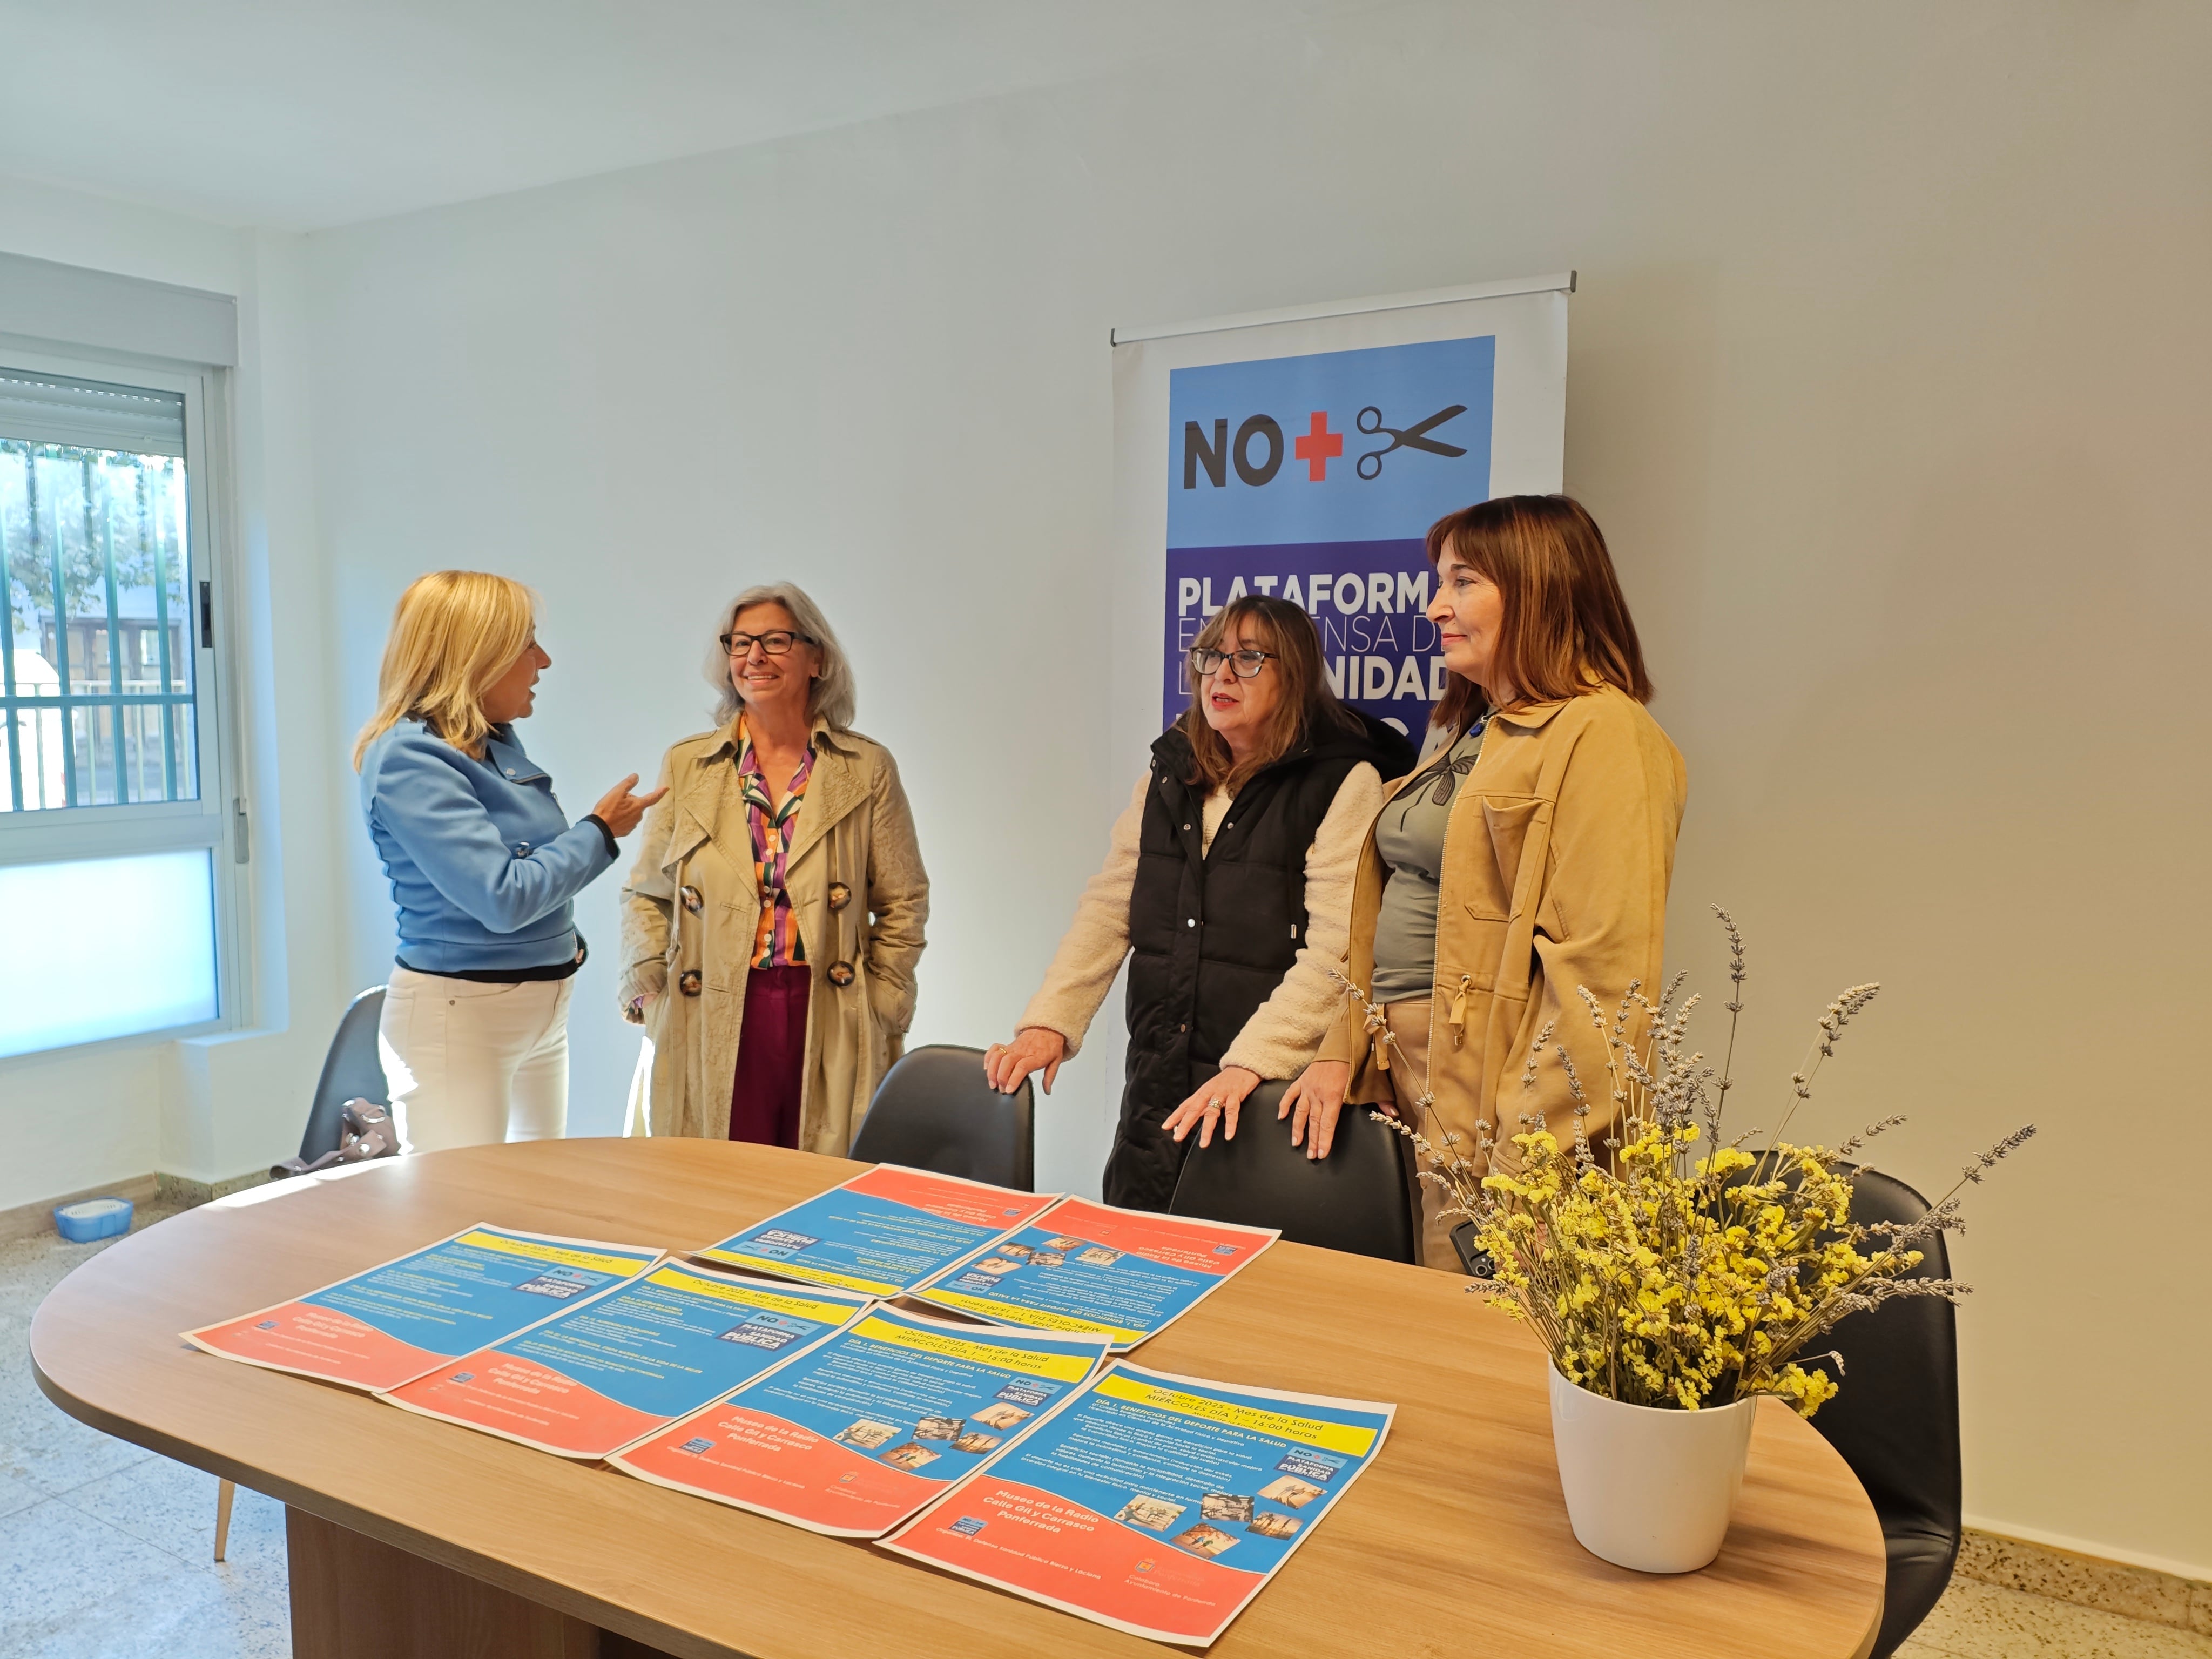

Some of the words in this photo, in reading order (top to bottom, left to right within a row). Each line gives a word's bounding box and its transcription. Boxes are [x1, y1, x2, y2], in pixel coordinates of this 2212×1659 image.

[1184, 414, 1284, 490] NO
[1179, 571, 1429, 616] PLATAFORM
[960, 1299, 986, 1307] horas
[1047, 1318, 1102, 1332] MIÉRCOLES
[720, 1331, 780, 1348] PÚBLICA
[895, 1334, 949, 1349] MIÉRCOLES
[987, 1354, 1013, 1363] 16:00
[1013, 1360, 1042, 1369] horas
[904, 1330, 941, 1341] Octubre
[942, 1338, 966, 1346] 2025
[1021, 1353, 1049, 1362] Salud
[869, 1344, 909, 1355] BENEFICIOS
[923, 1355, 955, 1366] DEPORTE
[986, 1370, 1011, 1378] SALUD
[997, 1391, 1042, 1404] PÚBLICA
[1007, 1385, 1047, 1397] PLATAFORMA
[1014, 1391, 1043, 1400] SANIDAD
[1144, 1394, 1206, 1412] MIÉRCOLES
[1209, 1409, 1228, 1418] DÍA
[1253, 1419, 1283, 1431] 16:00
[1284, 1427, 1317, 1439] horas
[1153, 1388, 1196, 1402] Octubre
[1198, 1399, 1224, 1409] 2025
[1233, 1407, 1256, 1417] Mes
[1291, 1419, 1323, 1431] Salud
[718, 1421, 744, 1432] Calle
[744, 1428, 760, 1436] Gil
[766, 1434, 812, 1450] Carrasco
[731, 1415, 764, 1428] Museo
[789, 1431, 819, 1442] Radio
[1120, 1405, 1166, 1419] BENEFICIOS
[1184, 1420, 1220, 1432] DEPORTE
[1220, 1428, 1244, 1438] PARA
[1258, 1437, 1286, 1447] SALUD
[727, 1432, 781, 1451] Ponferrada
[1293, 1449, 1312, 1457] NO
[1279, 1463, 1330, 1480] PÚBLICA
[1287, 1456, 1333, 1471] PLATAFORMA
[1297, 1463, 1331, 1475] SANIDAD
[983, 1496, 1013, 1508] Calle
[1014, 1505, 1032, 1514] Gil
[1041, 1513, 1094, 1531] Carrasco
[995, 1489, 1034, 1504] Museo
[1050, 1505, 1065, 1513] la
[1064, 1509, 1099, 1522] Radio
[997, 1510, 1061, 1533] Ponferrada
